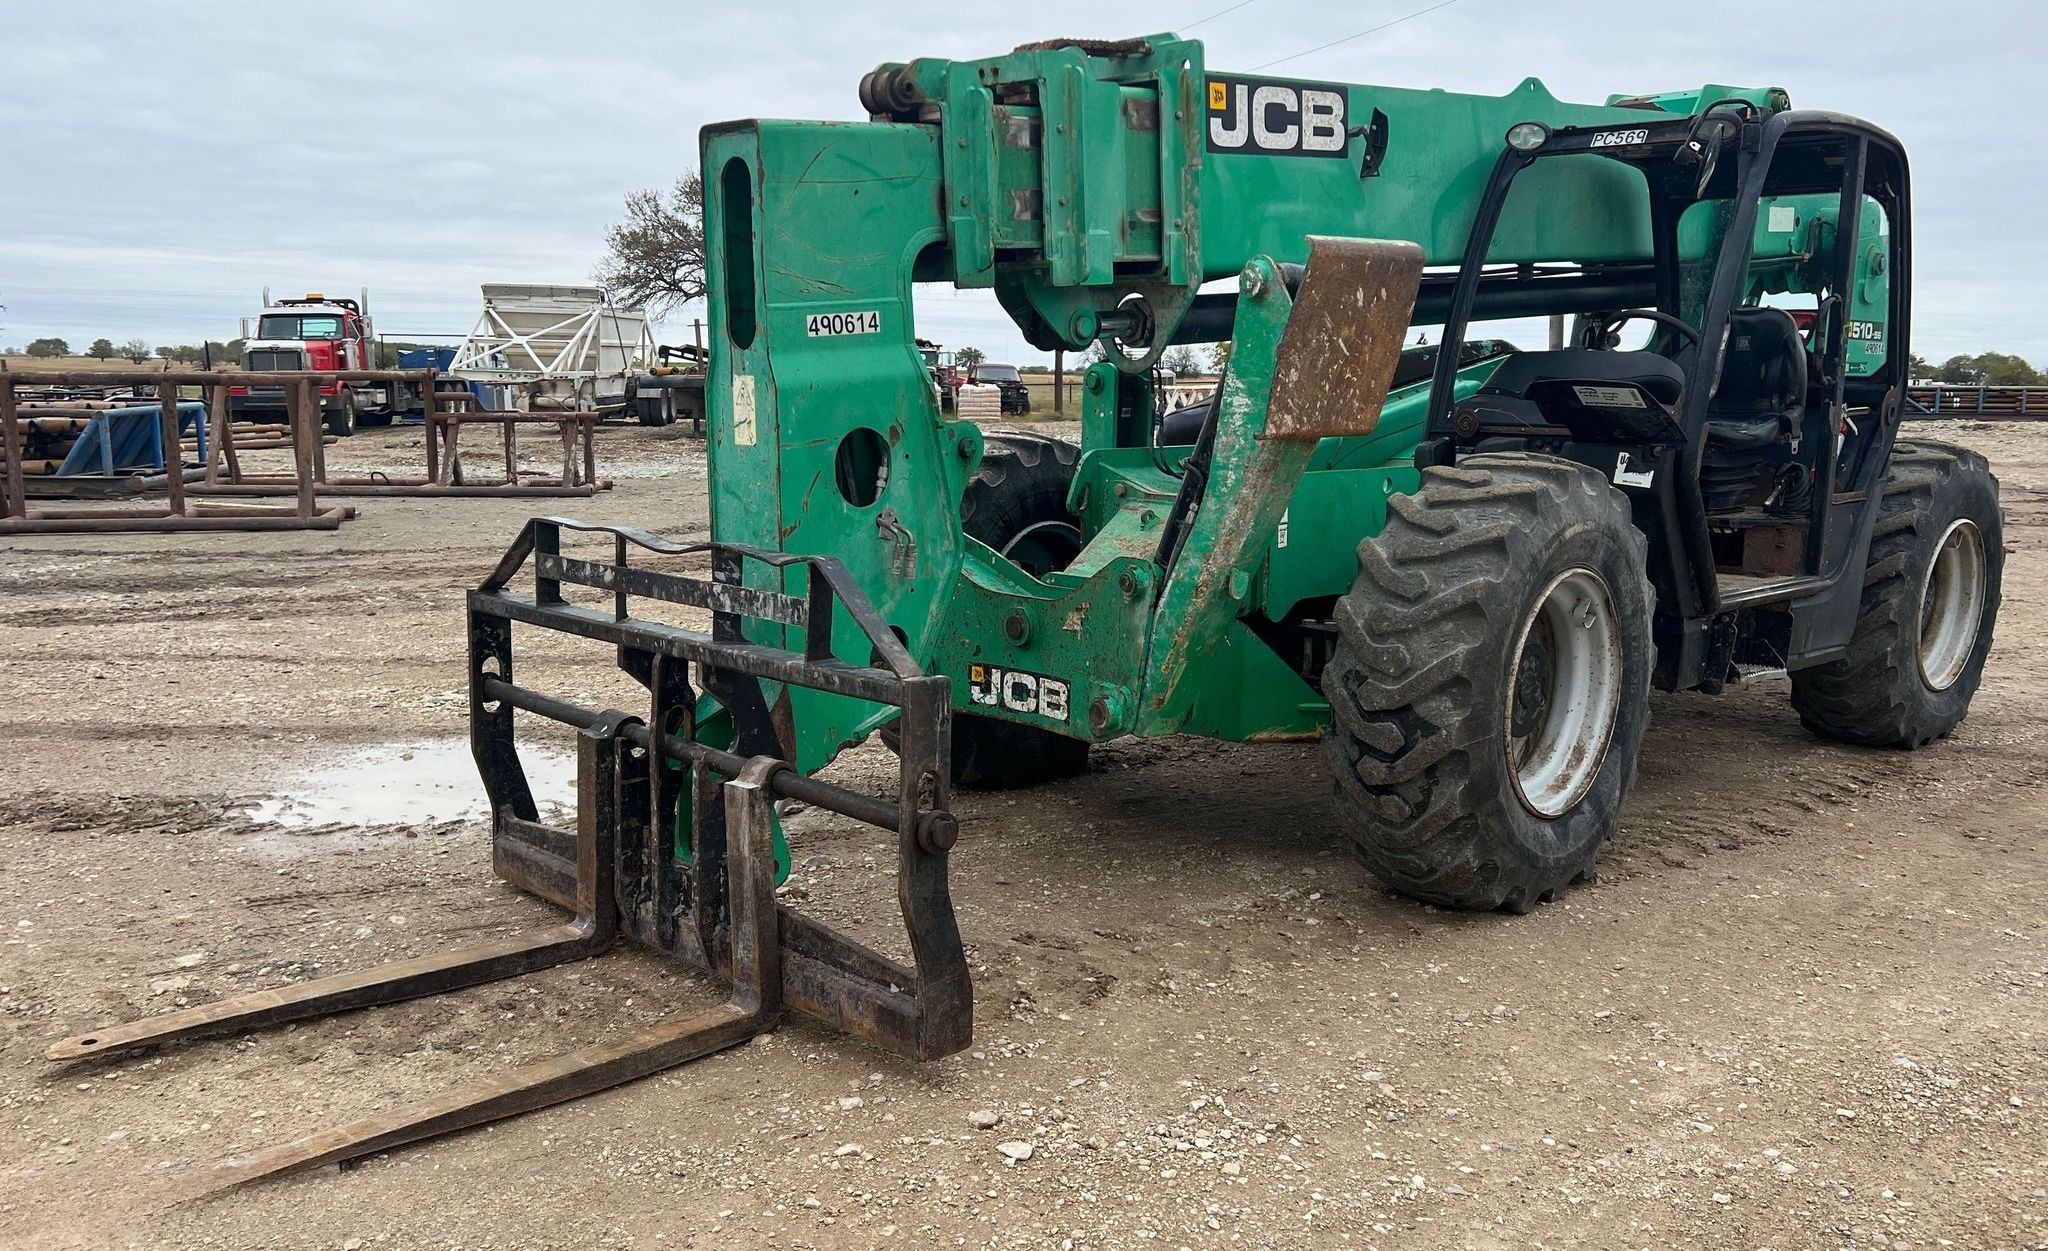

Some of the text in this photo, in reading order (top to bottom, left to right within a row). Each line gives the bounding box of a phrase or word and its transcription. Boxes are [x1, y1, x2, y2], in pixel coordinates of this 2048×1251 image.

[1210, 84, 1346, 152] JCB
[1592, 130, 1647, 146] PC569
[808, 312, 879, 336] 490614
[971, 668, 1068, 721] JCB
